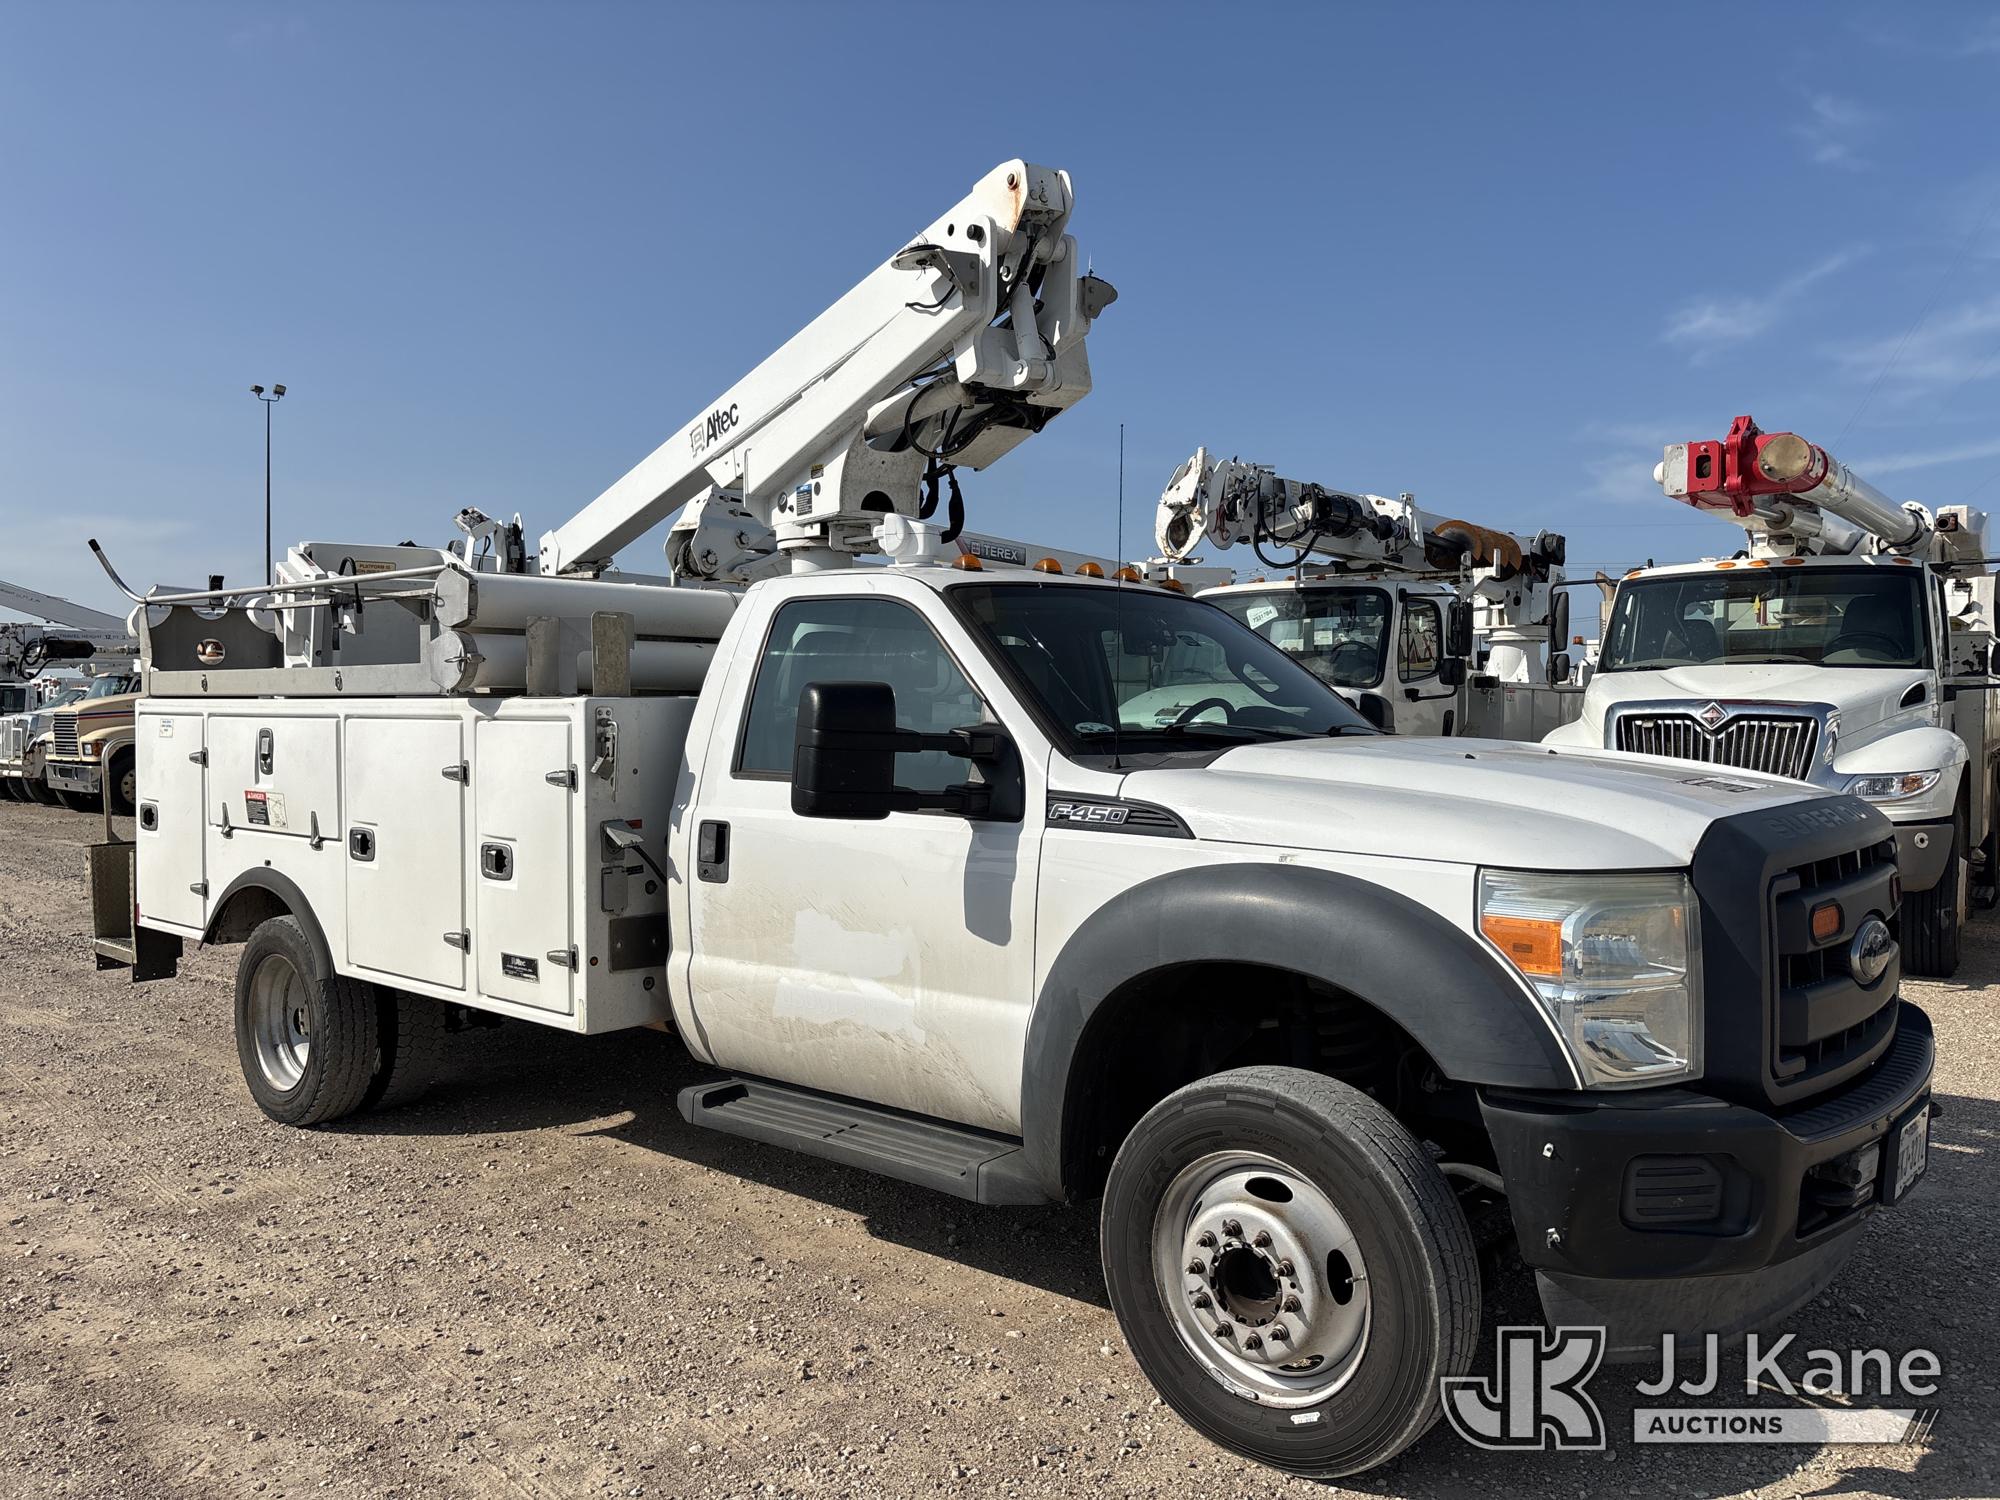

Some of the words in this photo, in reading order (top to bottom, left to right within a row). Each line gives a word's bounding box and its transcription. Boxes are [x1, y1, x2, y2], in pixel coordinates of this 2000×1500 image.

[706, 403, 739, 448] Altec
[983, 544, 1018, 561] TEREX
[1049, 803, 1129, 825] F-450
